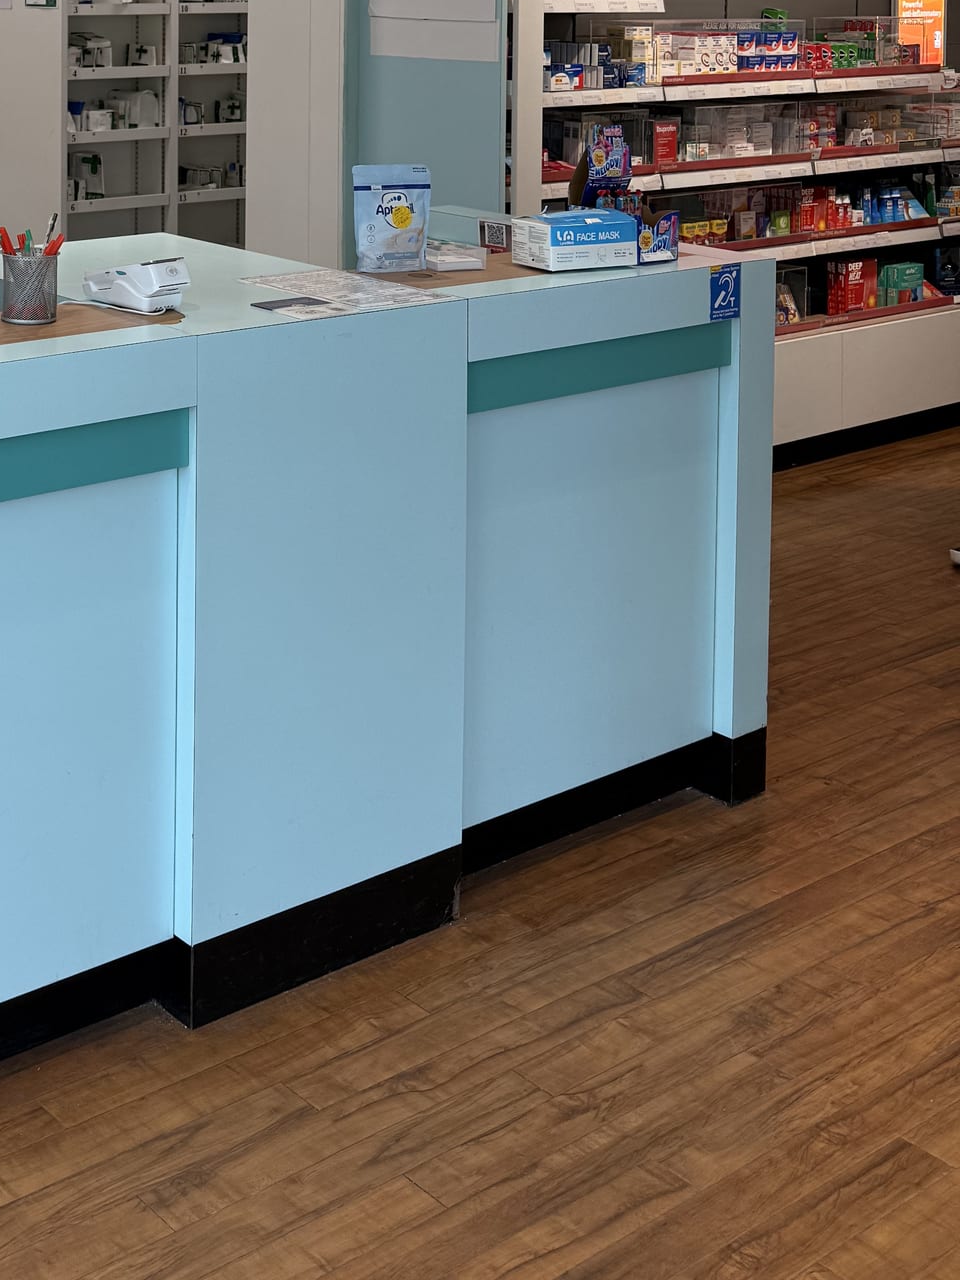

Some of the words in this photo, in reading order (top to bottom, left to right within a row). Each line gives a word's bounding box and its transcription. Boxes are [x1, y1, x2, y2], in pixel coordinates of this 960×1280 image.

[73, 6, 78, 14] 3
[703, 22, 718, 30] PLEASE
[376, 203, 415, 217] Aptil
[577, 232, 596, 241] FACE
[598, 231, 620, 240] MASK
[848, 262, 863, 271] DEEP
[848, 271, 861, 280] HEAT
[730, 297, 735, 307] T
